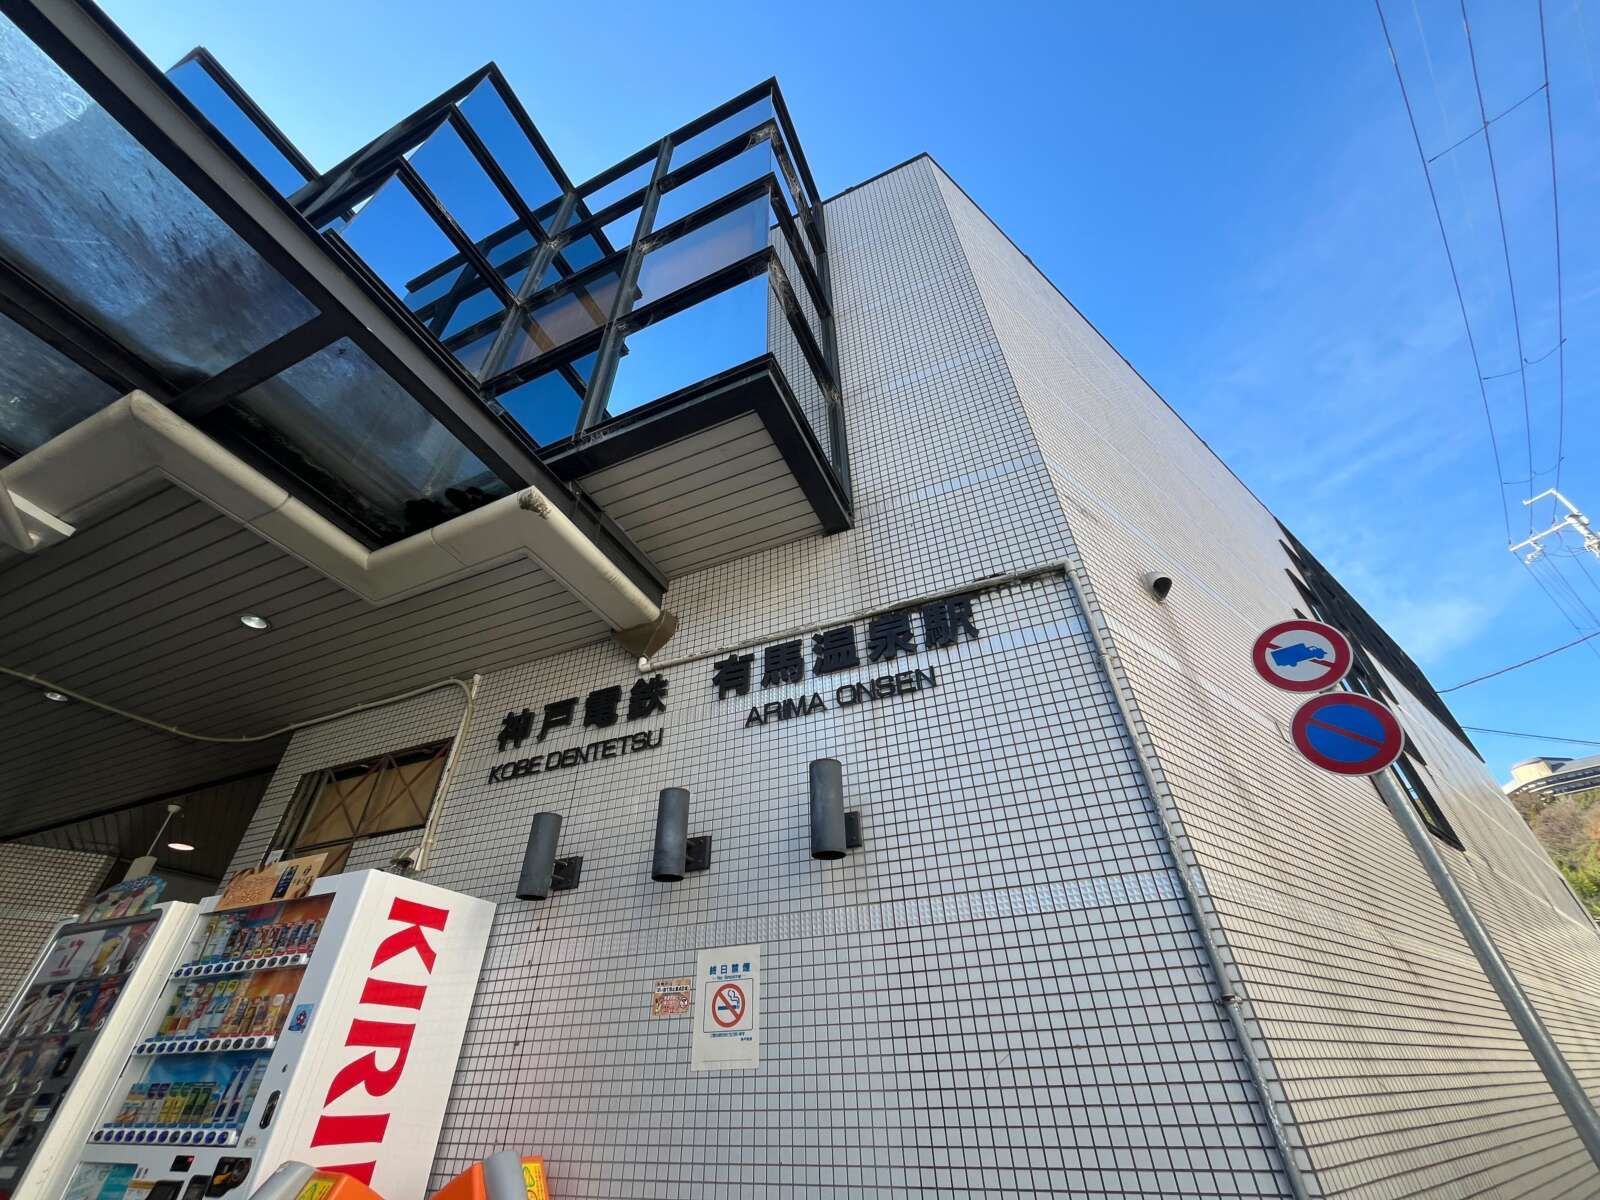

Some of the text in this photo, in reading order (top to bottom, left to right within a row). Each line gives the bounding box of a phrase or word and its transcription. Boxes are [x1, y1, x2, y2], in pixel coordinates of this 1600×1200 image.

[712, 594, 980, 700] 有馬温泉駅
[497, 673, 669, 751] 神戸電鉄
[745, 666, 937, 728] ARIMA ONSEN
[488, 727, 664, 784] KOBE DENTETSU
